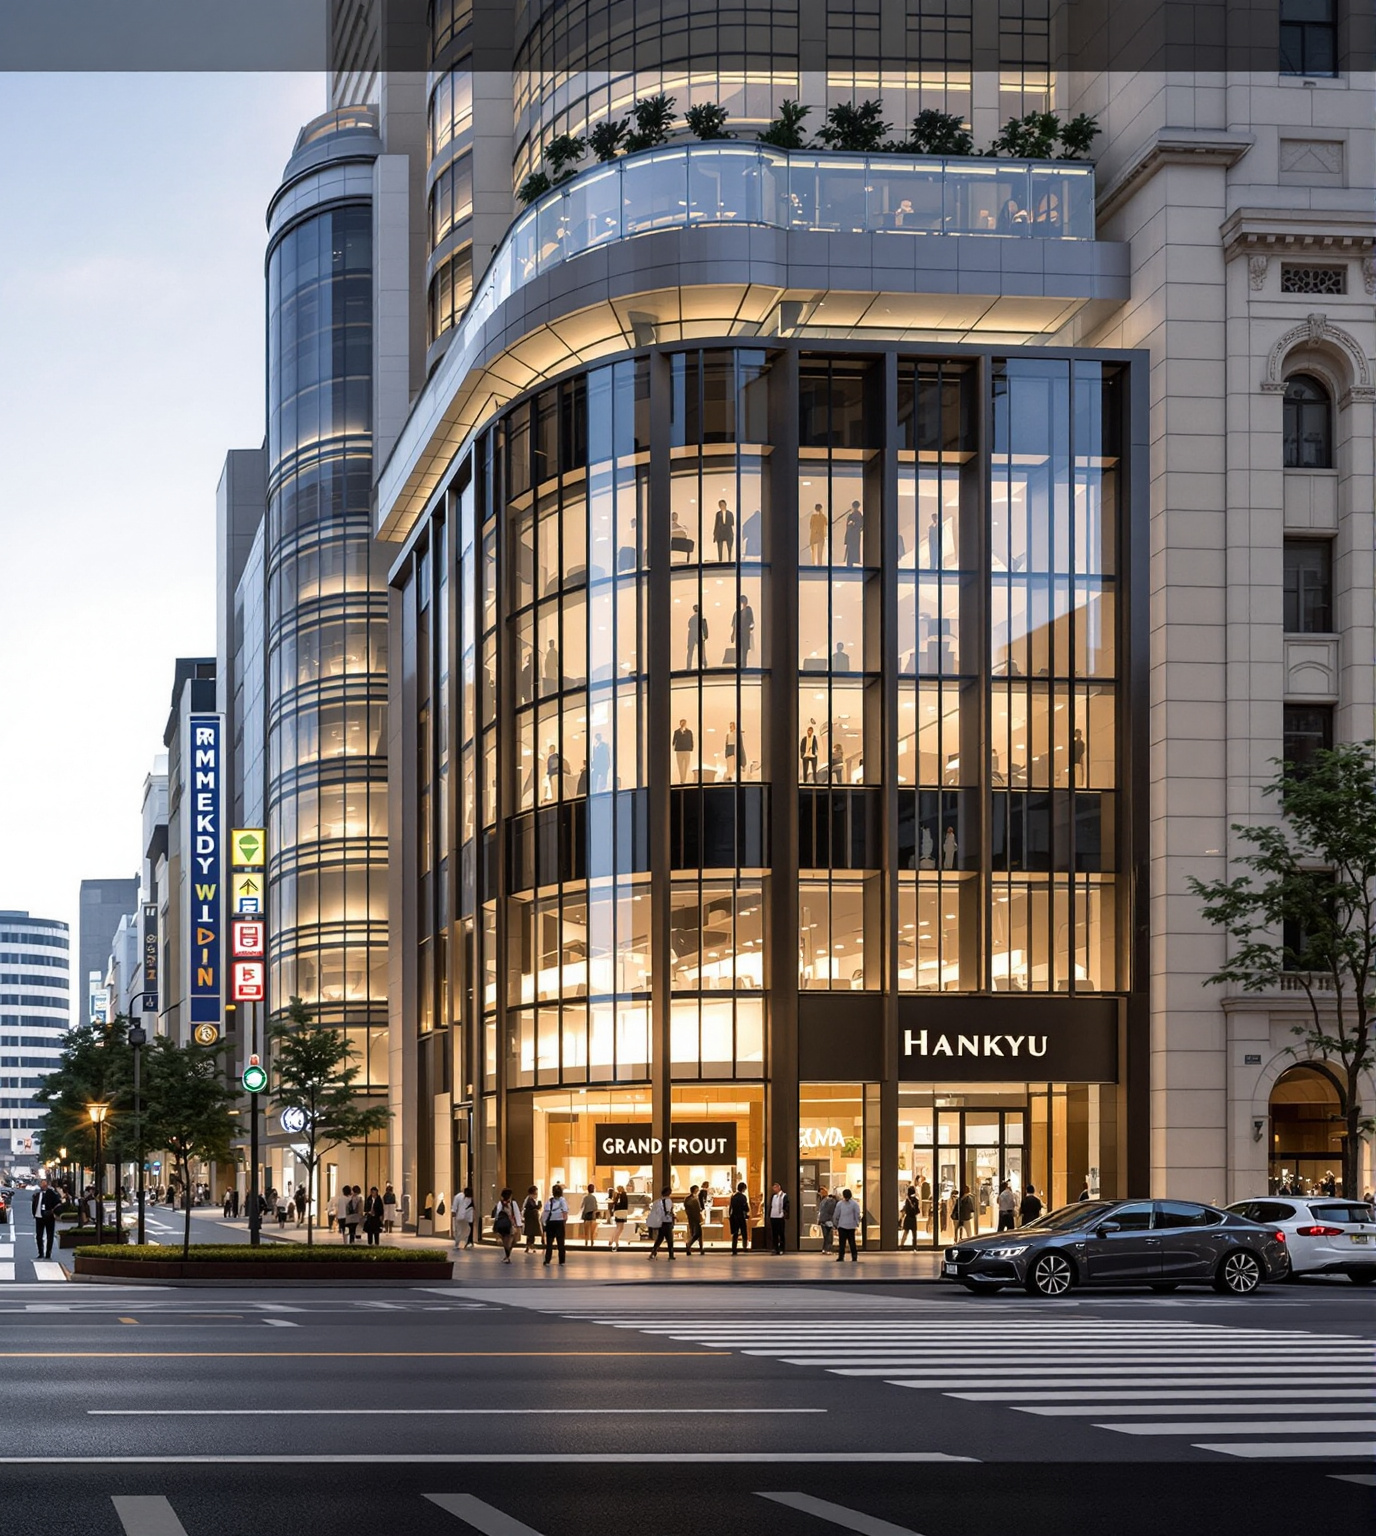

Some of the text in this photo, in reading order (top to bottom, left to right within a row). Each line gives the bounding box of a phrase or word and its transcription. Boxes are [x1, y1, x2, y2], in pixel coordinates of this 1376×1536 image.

[904, 1029, 1049, 1057] HANKYU
[602, 1137, 728, 1155] GRAND FROUT
